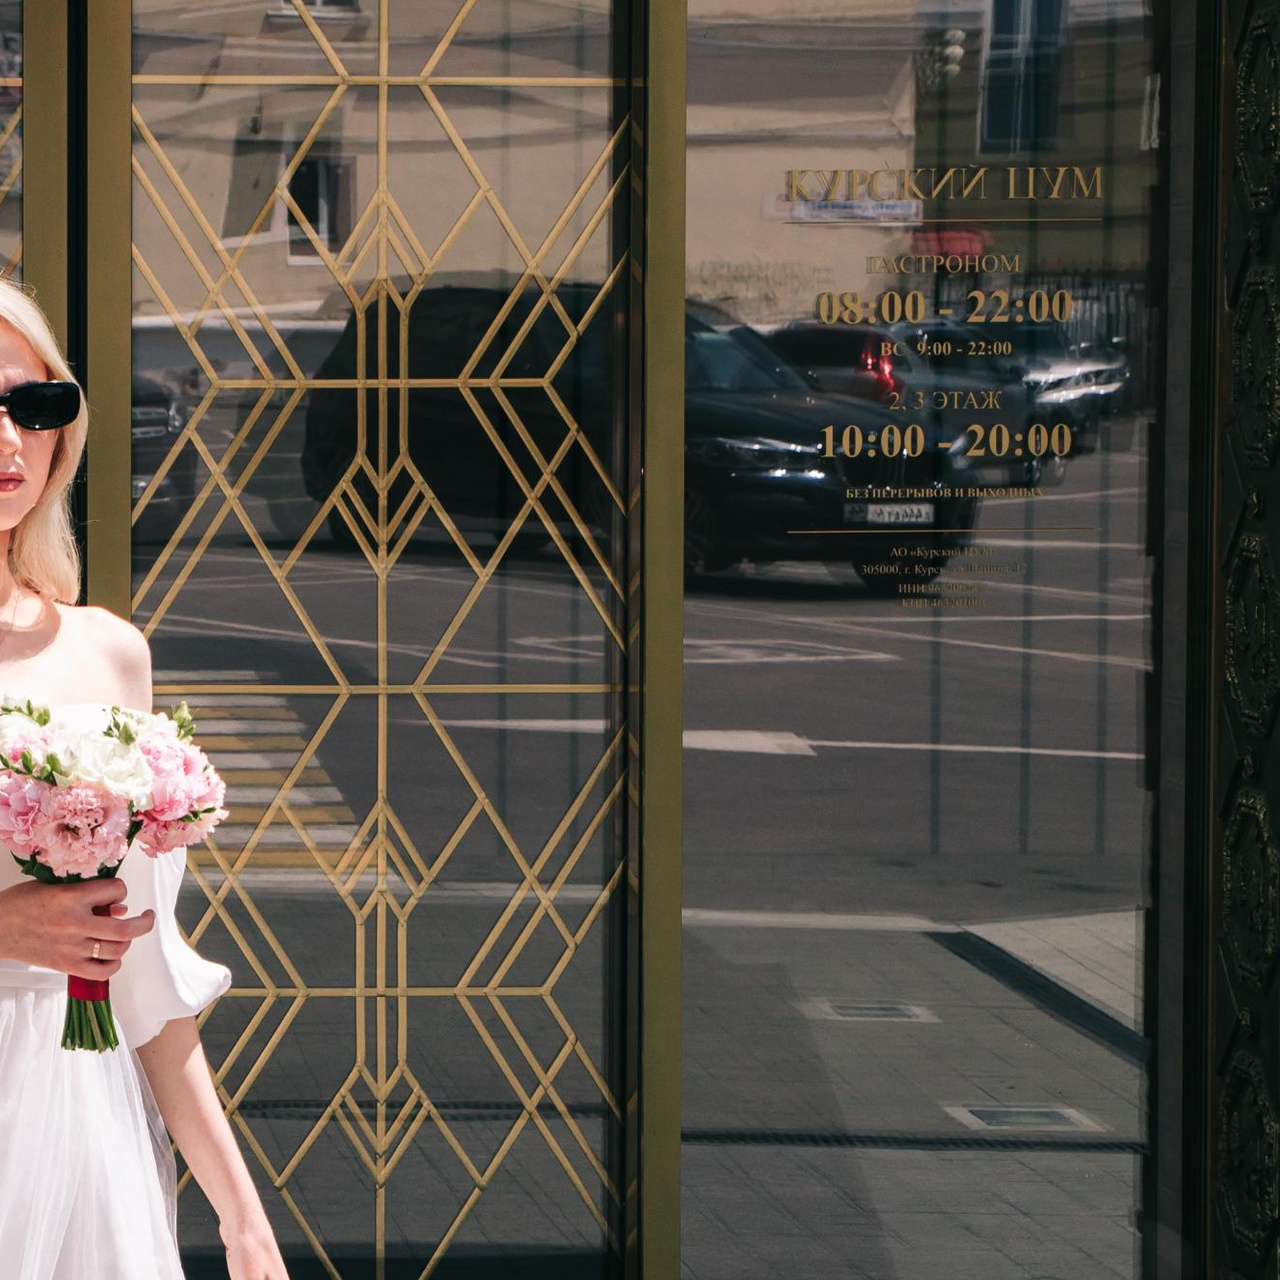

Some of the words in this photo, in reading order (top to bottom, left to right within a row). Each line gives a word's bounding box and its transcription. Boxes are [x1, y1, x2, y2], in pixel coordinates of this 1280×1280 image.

[785, 163, 987, 201] КУРСКИЙ
[1007, 166, 1104, 201] ЦУМ
[867, 254, 1021, 274] ГАСТРОНОМ
[818, 289, 926, 325] 08:00
[966, 289, 1073, 324] 22:00
[880, 342, 907, 357] ВС
[917, 341, 952, 356] 9:00
[968, 341, 1012, 356] 22:00
[913, 391, 925, 410] 3
[932, 390, 1002, 410] ЭТАЖ
[820, 424, 926, 459] 10:00
[966, 423, 1072, 457] 20:00
[846, 488, 869, 499] БЕЗ
[872, 488, 952, 499] ПЕРЕРЫВОВ
[955, 488, 964, 498] И
